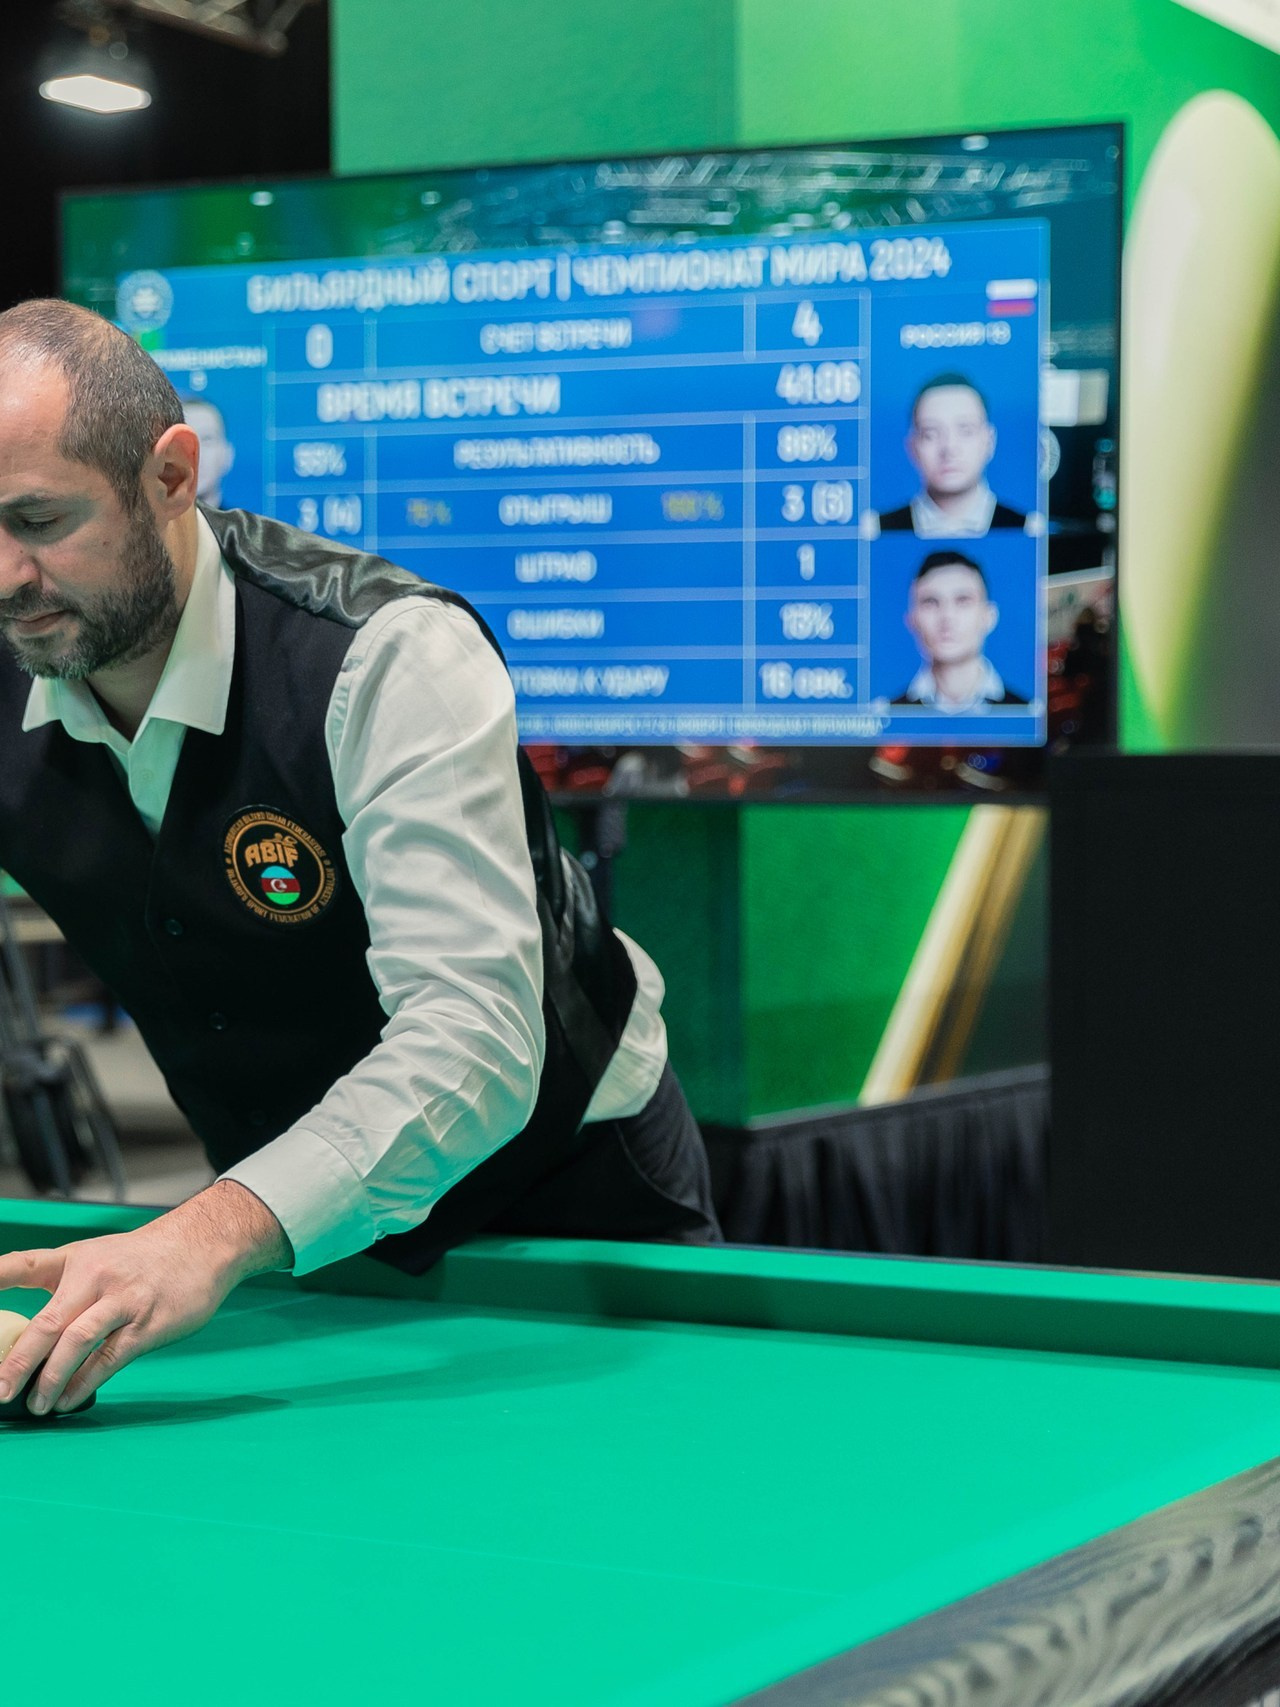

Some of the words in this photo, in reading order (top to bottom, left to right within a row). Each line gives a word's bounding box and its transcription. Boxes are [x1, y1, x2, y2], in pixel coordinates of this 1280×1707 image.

[247, 257, 450, 313] БИЛЬЯРДНЫЙ
[453, 257, 554, 302] СПОРТ
[572, 248, 767, 295] ЧЕМПИОНАТ
[771, 242, 868, 284] МИРА
[869, 237, 952, 281] 2024
[535, 317, 632, 351] ВСТРЕЧИ
[791, 299, 823, 347] 4
[306, 323, 334, 369] 0
[317, 380, 421, 422] ВРЕМЯ
[423, 374, 561, 418] ВСТРЕЧИ
[782, 484, 805, 522] 3
[797, 543, 816, 581] 1
[507, 609, 605, 640] ОШИБКИ
[244, 842, 299, 868] ABIF
